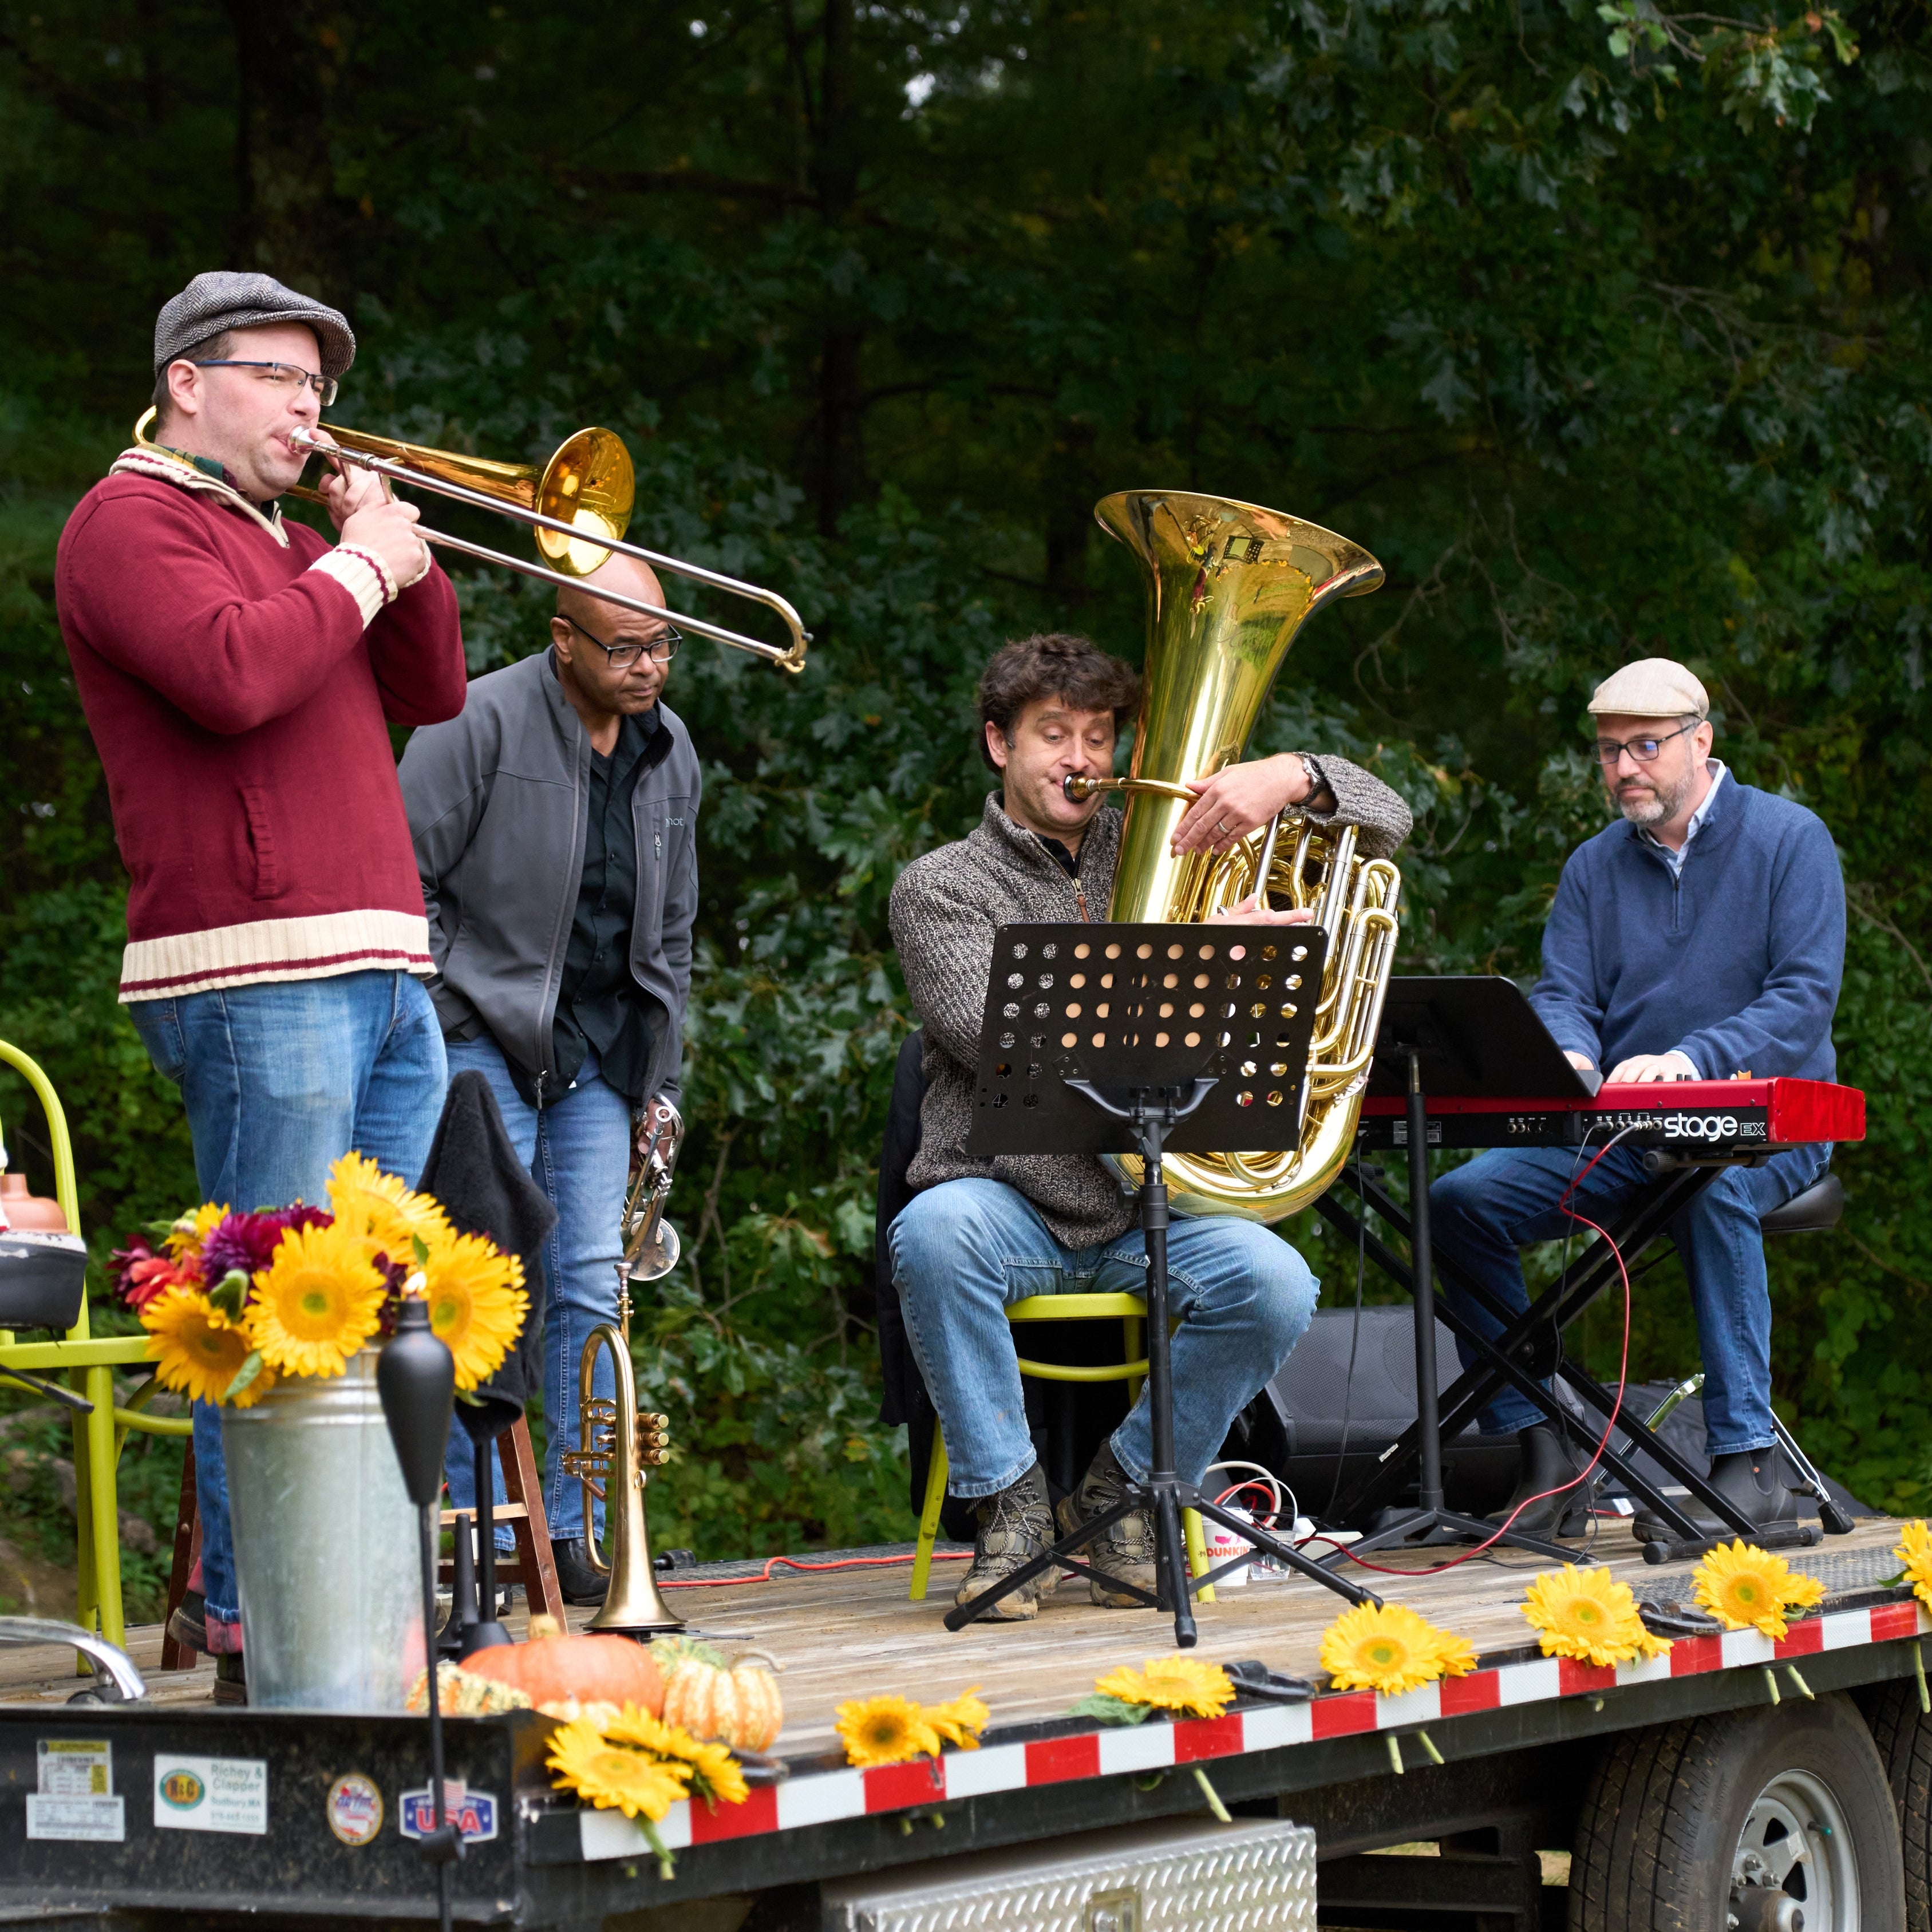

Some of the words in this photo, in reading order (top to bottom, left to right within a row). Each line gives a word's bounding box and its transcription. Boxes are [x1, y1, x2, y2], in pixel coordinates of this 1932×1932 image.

[1664, 1113, 1738, 1142] stage
[1740, 1123, 1766, 1136] EX
[211, 1764, 251, 1781] Richey
[254, 1767, 263, 1779] &
[212, 1776, 260, 1793] Clapper
